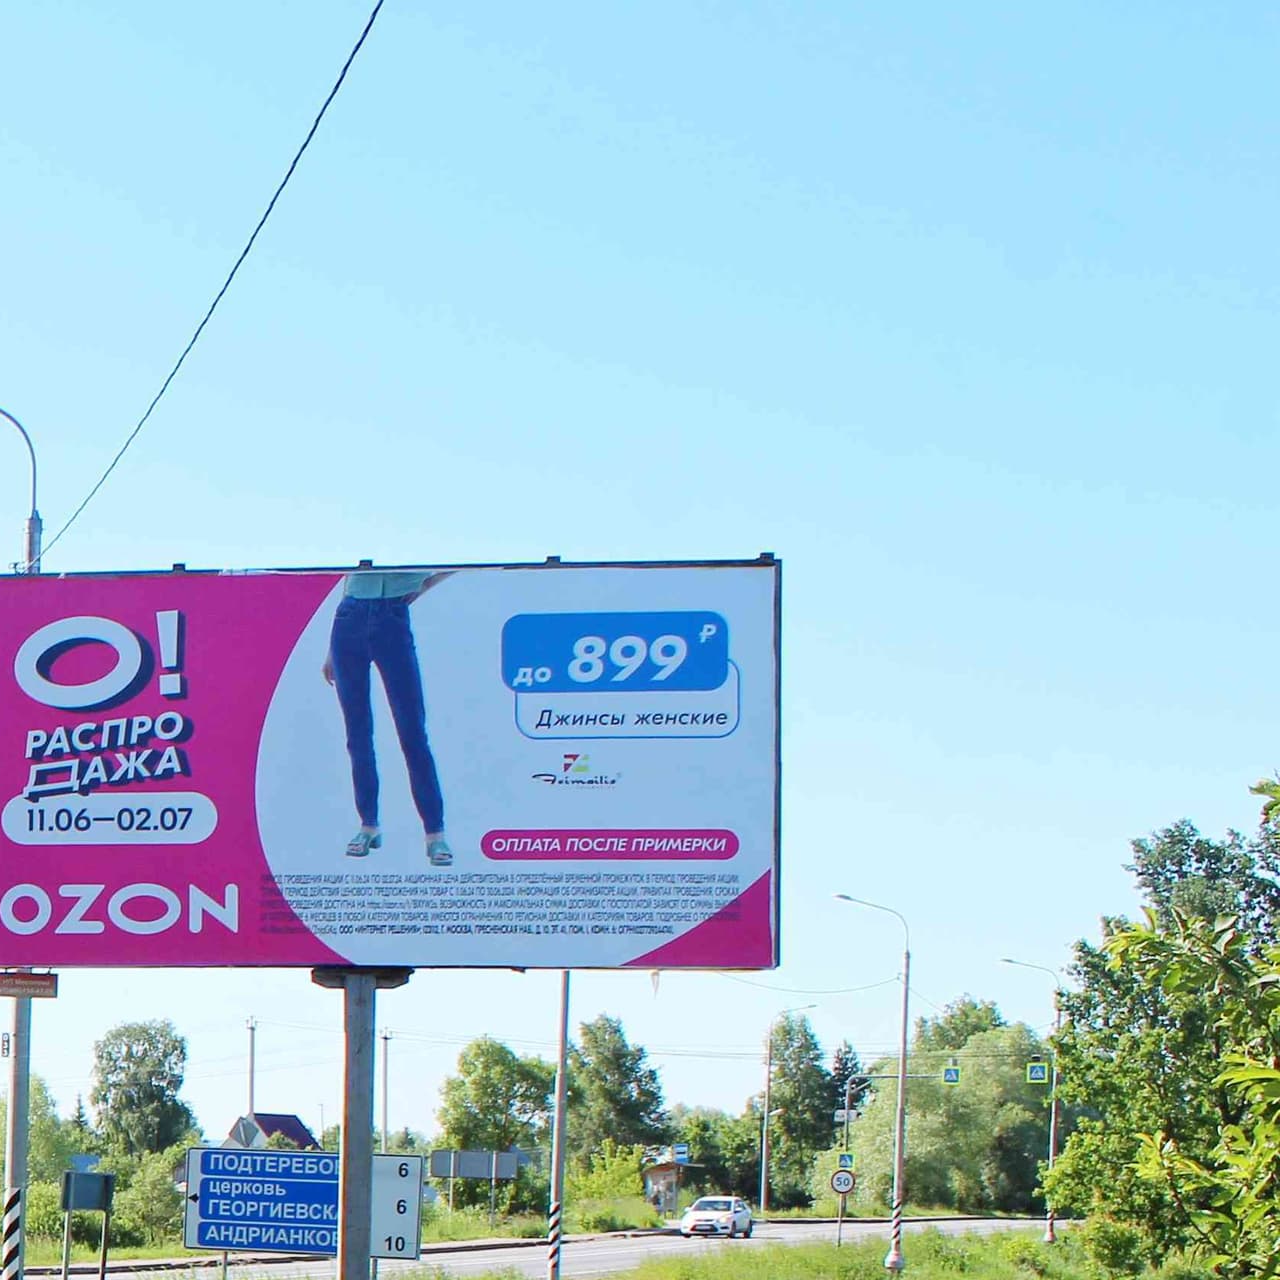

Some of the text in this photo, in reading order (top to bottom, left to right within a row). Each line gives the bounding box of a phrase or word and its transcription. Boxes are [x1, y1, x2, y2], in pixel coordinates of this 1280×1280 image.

[512, 666, 552, 687] до
[567, 634, 688, 684] 899
[535, 709, 728, 729] Джинсы женские
[25, 711, 185, 759] РАСПРО
[23, 746, 183, 799] ДАЖА
[492, 837, 727, 852] ОПЛАТА ПОСЛЕ ПРИМЕРКИ
[0, 883, 239, 936] OZON
[398, 1163, 409, 1178] 6
[209, 1181, 287, 1197] церковь
[836, 1177, 850, 1186] 50
[396, 1199, 407, 1215] 6
[385, 1236, 405, 1251] 10
